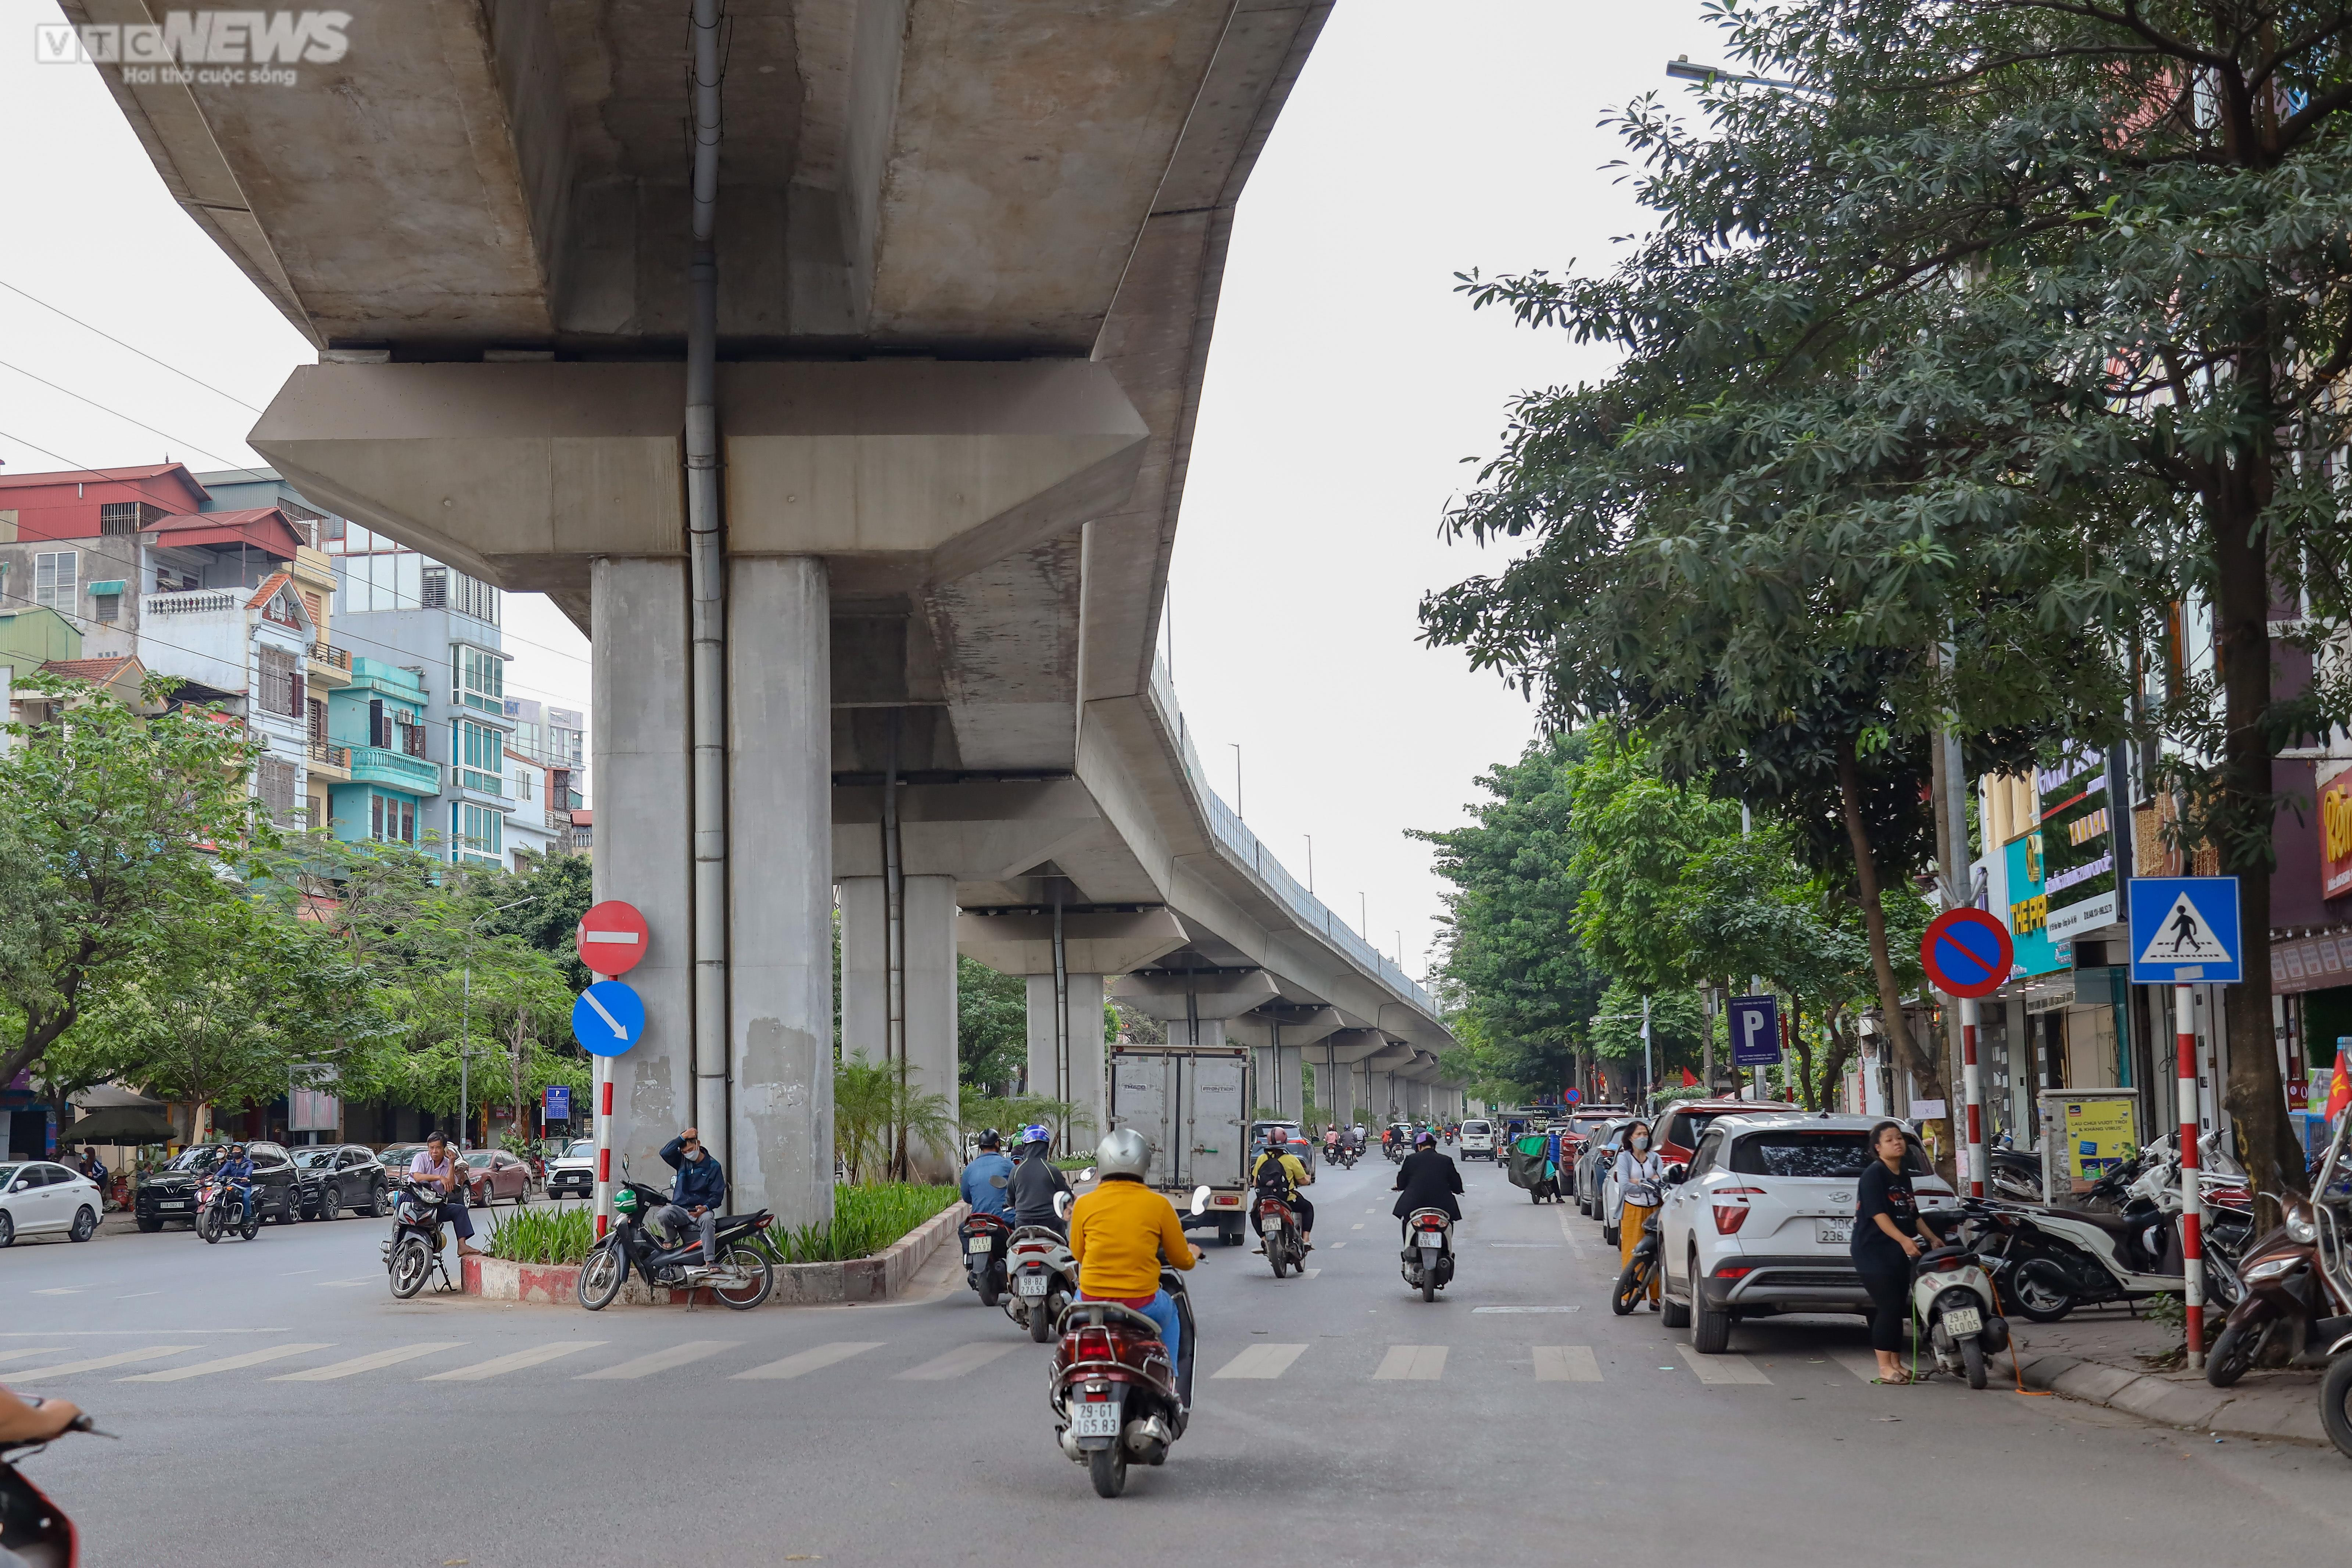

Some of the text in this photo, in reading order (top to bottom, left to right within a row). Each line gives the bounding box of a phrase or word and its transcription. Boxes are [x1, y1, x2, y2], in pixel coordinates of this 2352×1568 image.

[2010, 901, 2030, 935] THE
[1742, 1010, 1764, 1047] P
[1021, 1286, 1045, 1295] 276.52
[1948, 1310, 1973, 1323] 29-P1
[1948, 1319, 1979, 1334] 640.05
[1080, 1404, 1112, 1418] 29-G1
[1077, 1419, 1116, 1434] 165.83
